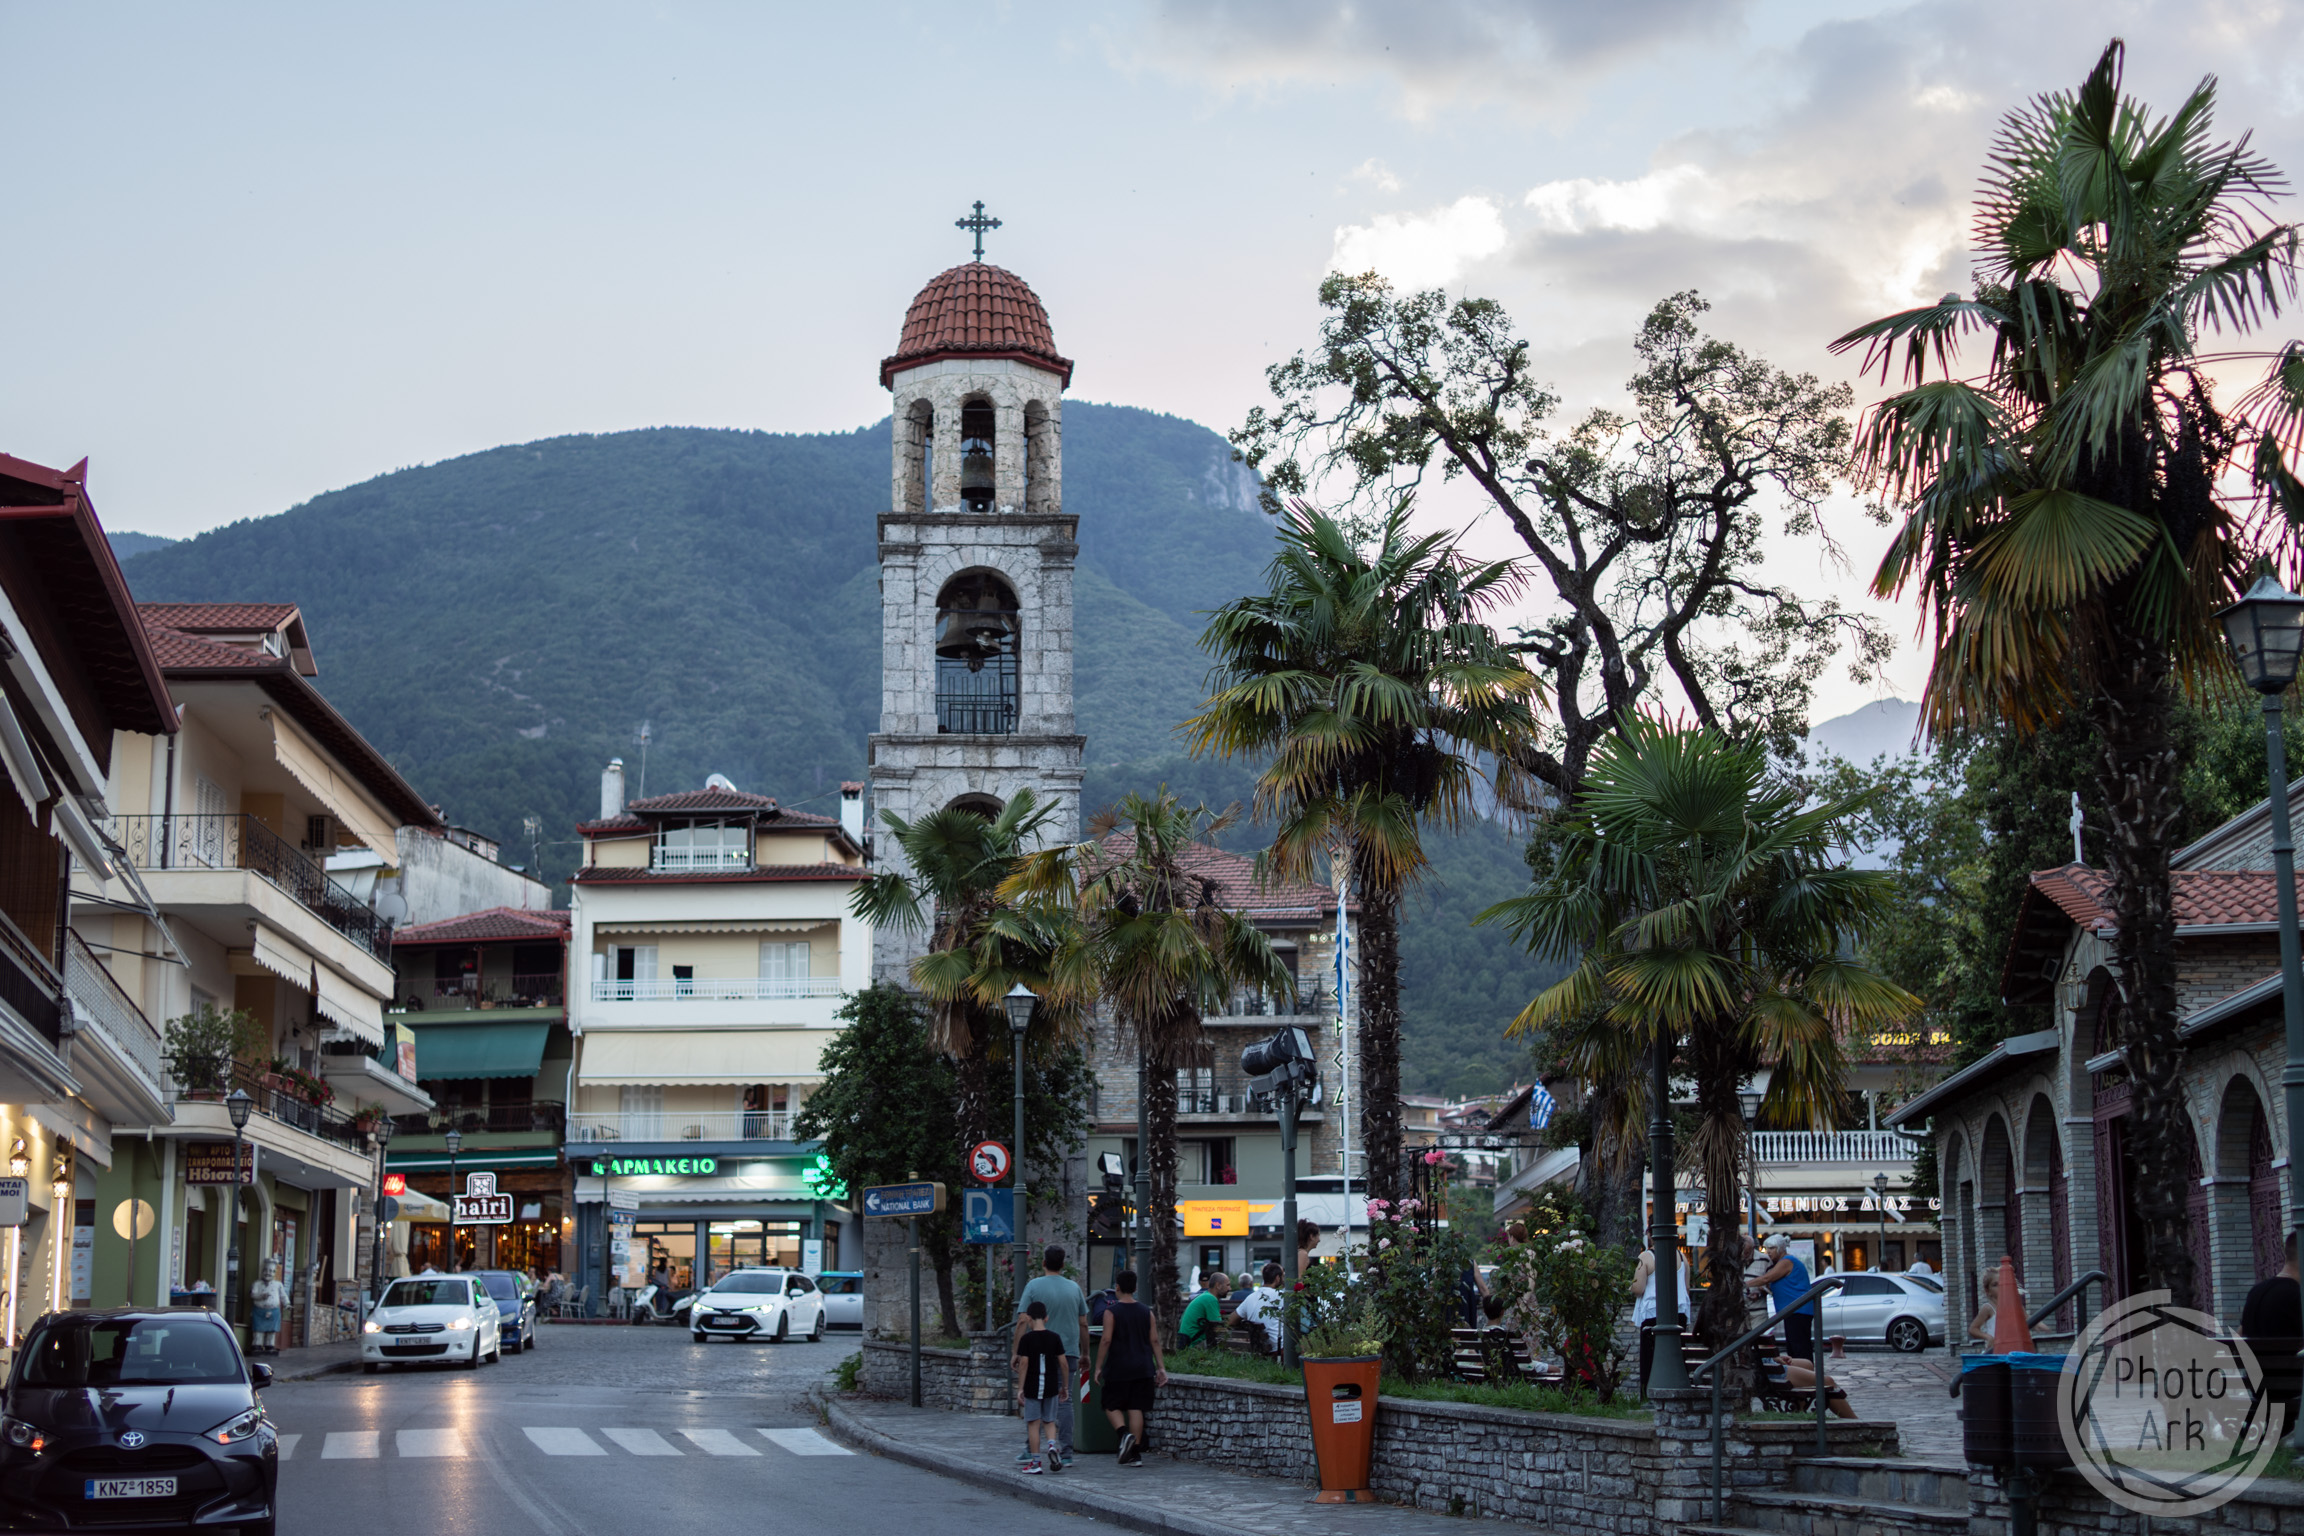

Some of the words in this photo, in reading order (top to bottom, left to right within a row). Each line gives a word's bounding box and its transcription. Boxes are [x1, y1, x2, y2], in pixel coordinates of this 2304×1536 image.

[1309, 932, 1355, 943] HOTL
[187, 1157, 253, 1167] ΖΑΧΑΡΟΠΛΑΣΕΙΟ
[384, 1176, 403, 1193] illy
[881, 1202, 911, 1211] NATIONAL
[913, 1200, 930, 1209] BANK
[1766, 1197, 1849, 1212] ΞΕΝΙΟΣ
[1860, 1196, 1912, 1211] ΔΙΑΣ
